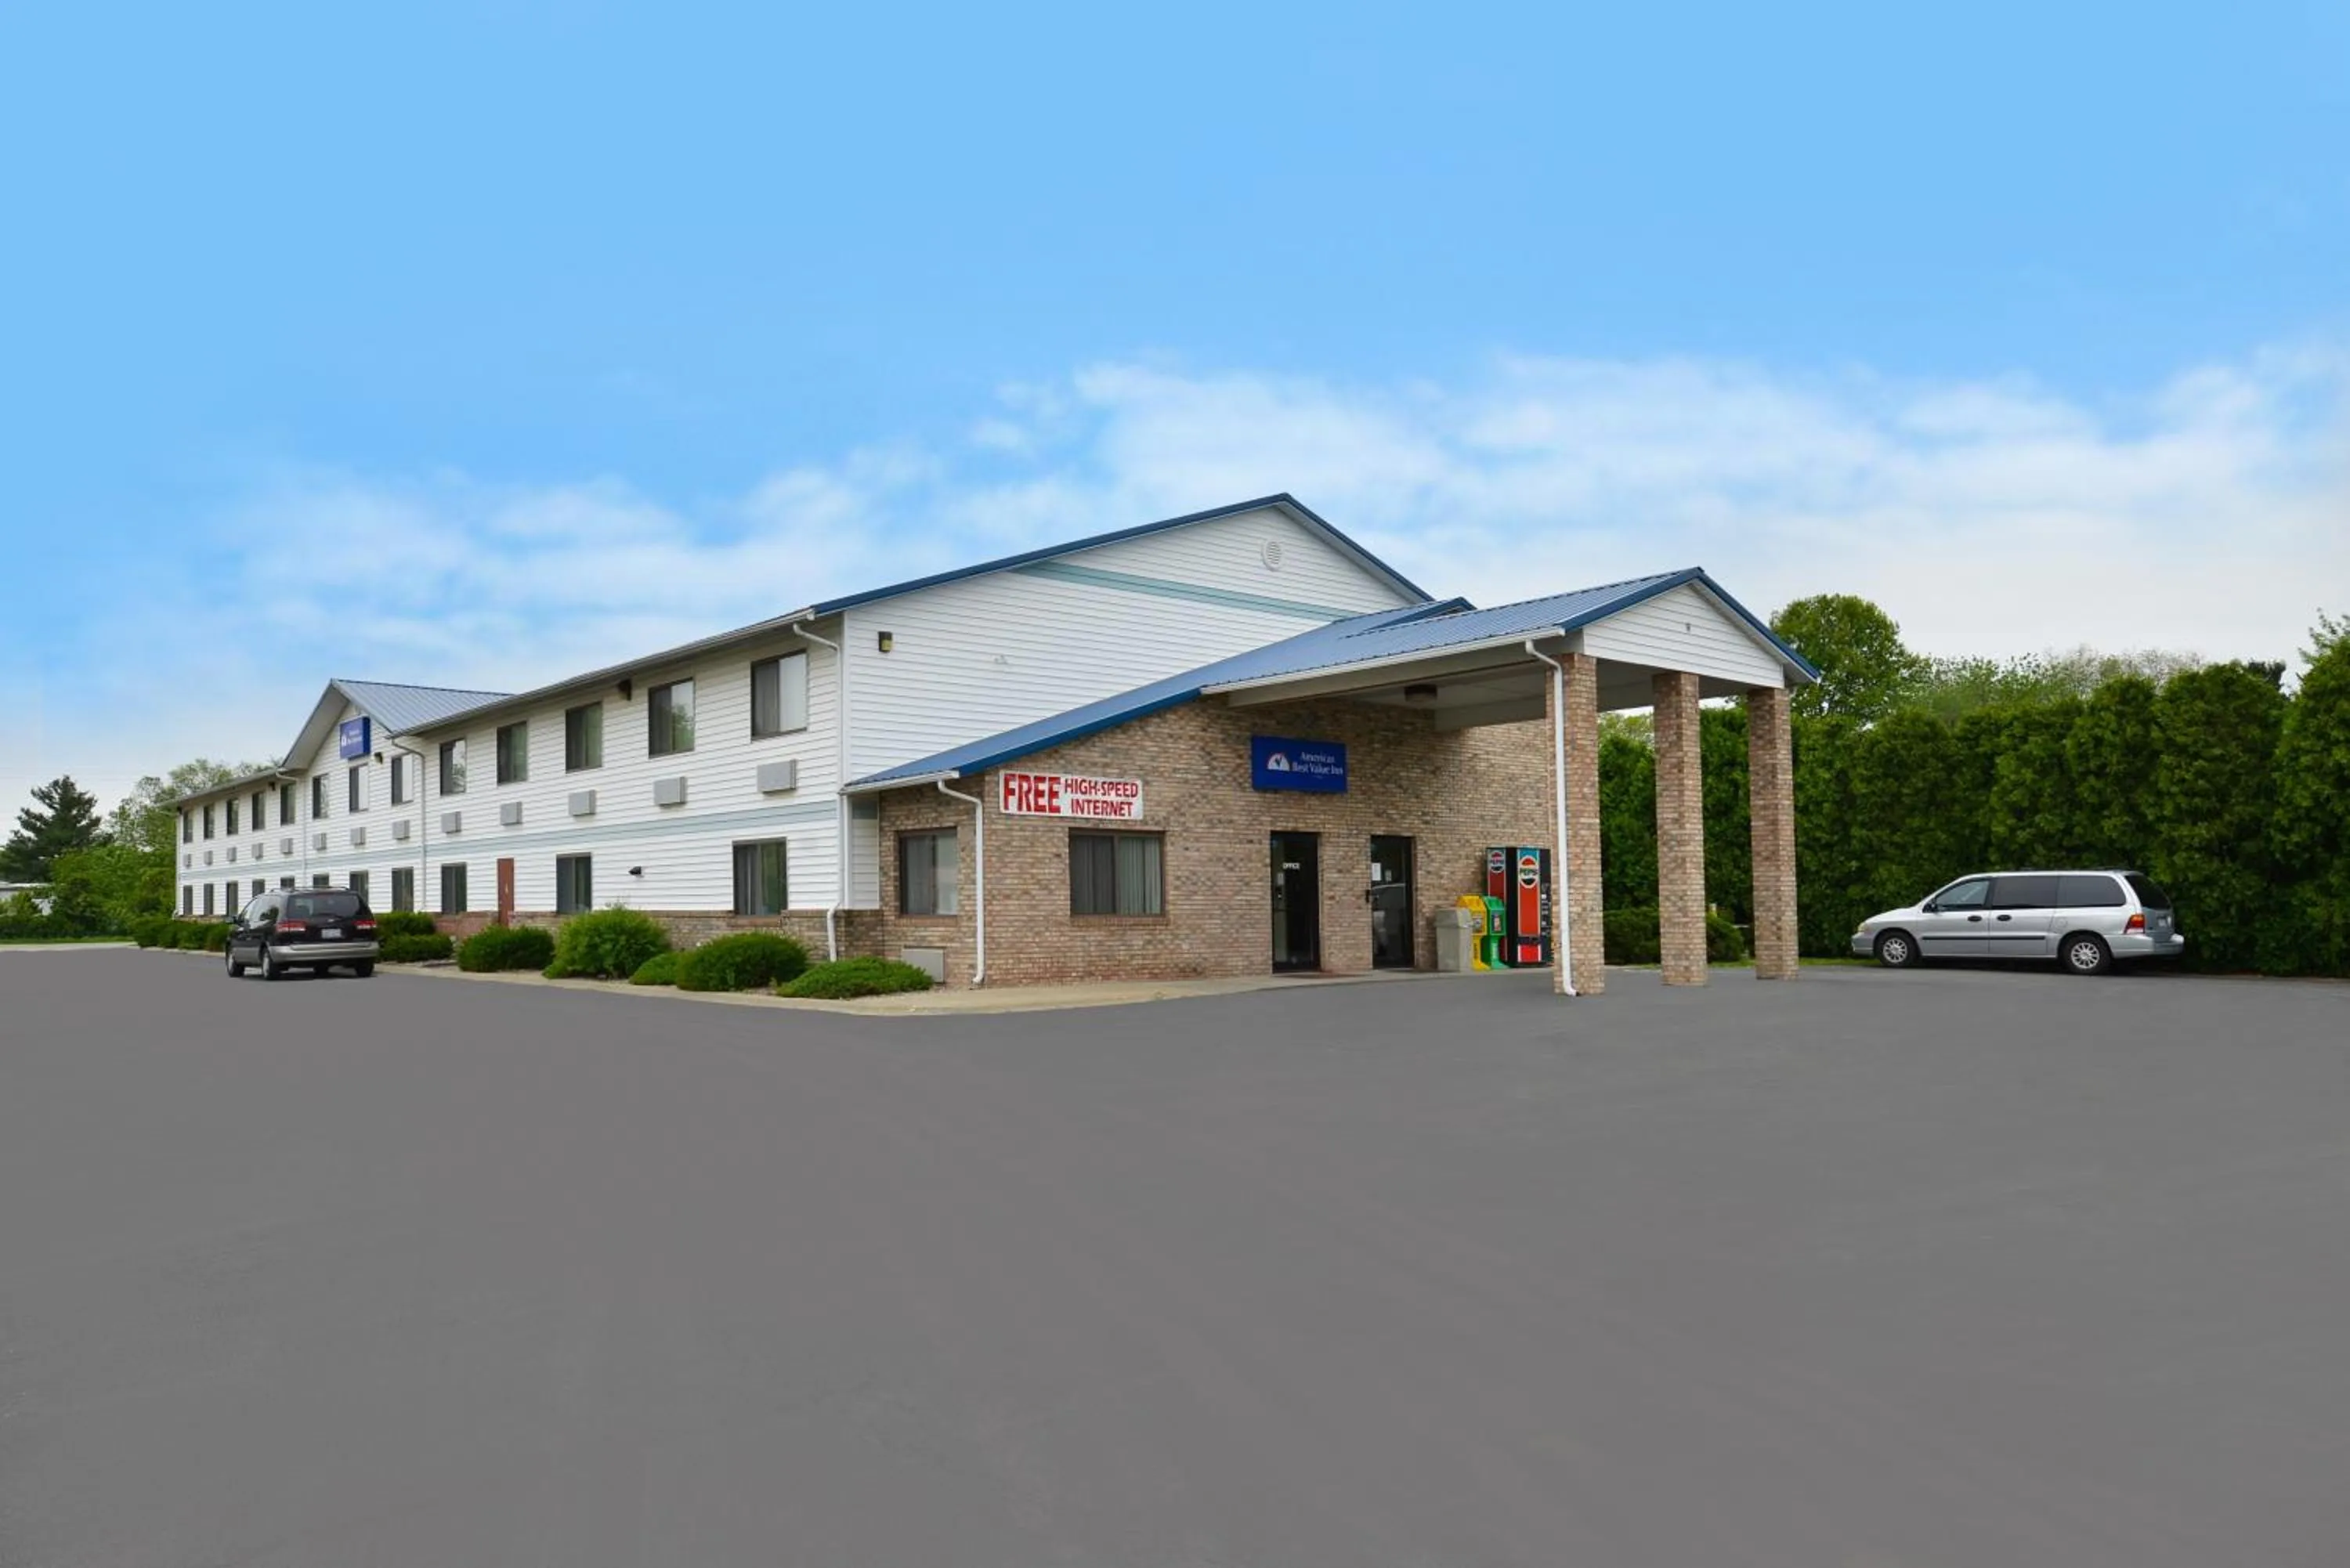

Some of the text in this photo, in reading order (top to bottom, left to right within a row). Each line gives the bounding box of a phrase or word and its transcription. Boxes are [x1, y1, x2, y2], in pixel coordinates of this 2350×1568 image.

[1003, 773, 1061, 814] FREE
[1065, 779, 1138, 797] HIGH-SPEED
[1071, 799, 1133, 816] INTERNET
